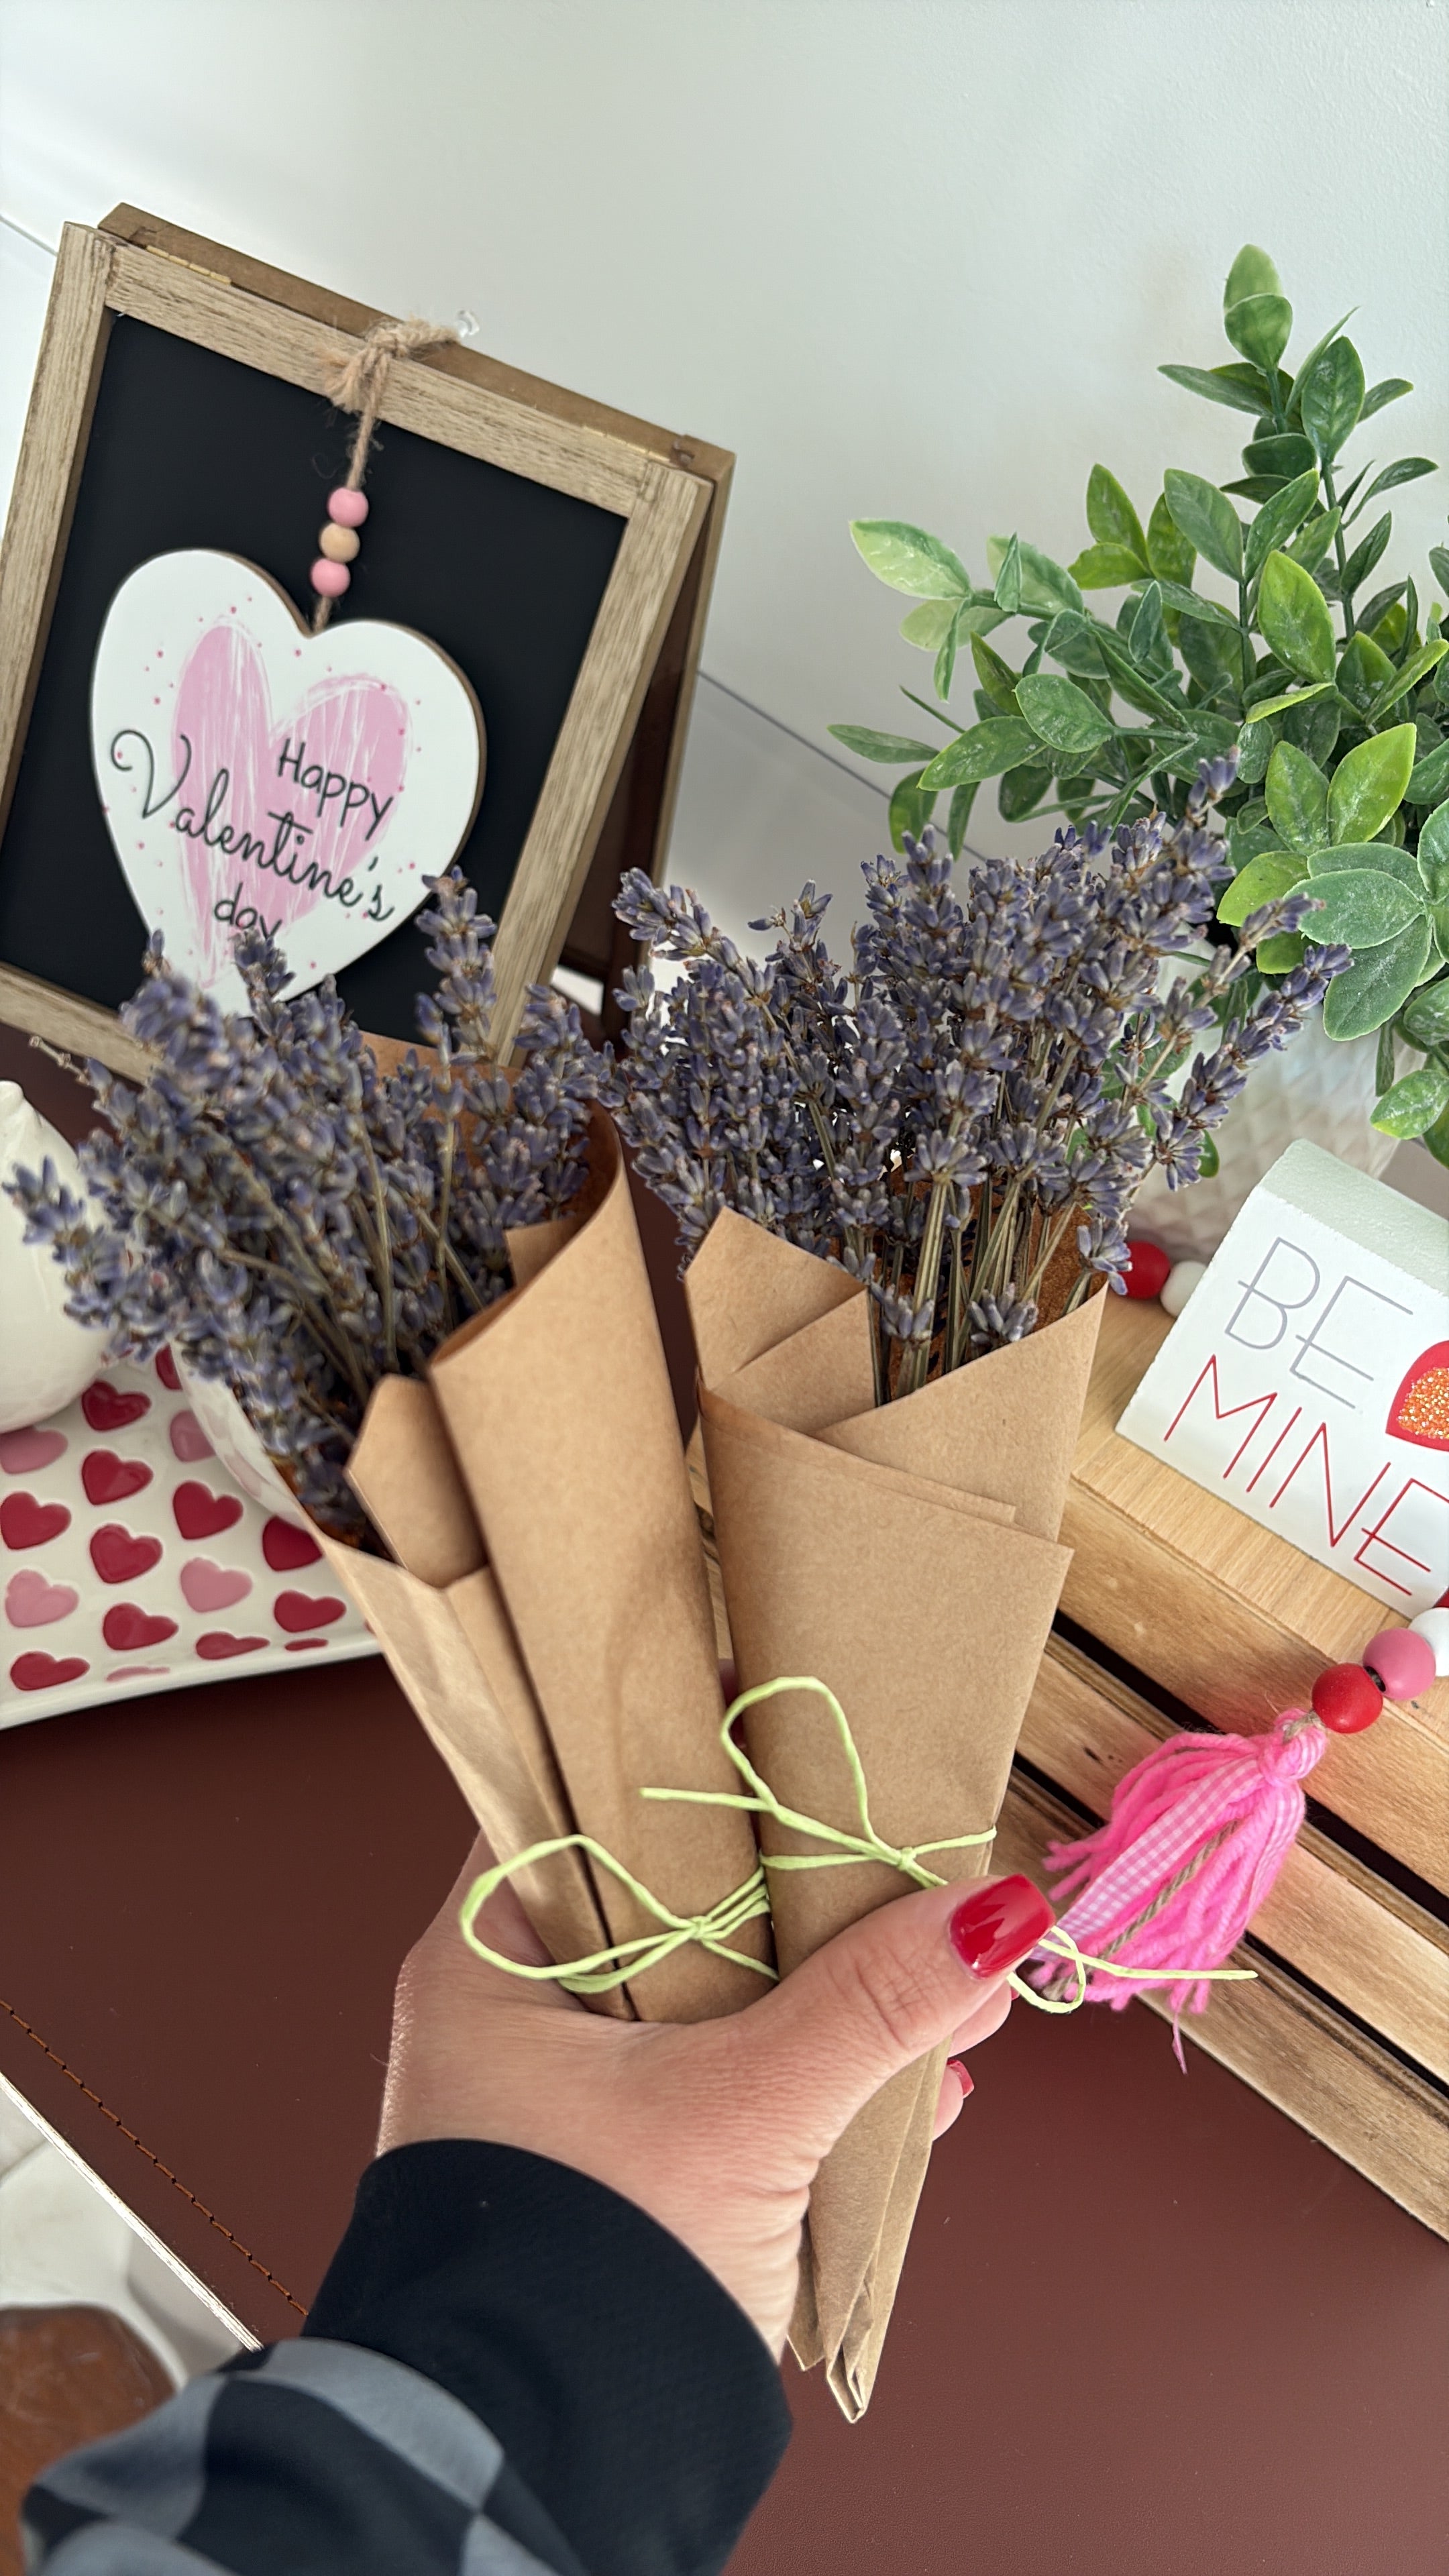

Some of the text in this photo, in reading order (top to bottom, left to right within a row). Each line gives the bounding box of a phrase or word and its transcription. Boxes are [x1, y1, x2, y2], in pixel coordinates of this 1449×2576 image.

[111, 730, 395, 922] Valentine's
[277, 738, 394, 841] Happy
[1225, 1237, 1413, 1409] BE
[1164, 1354, 1449, 1595] MINE
